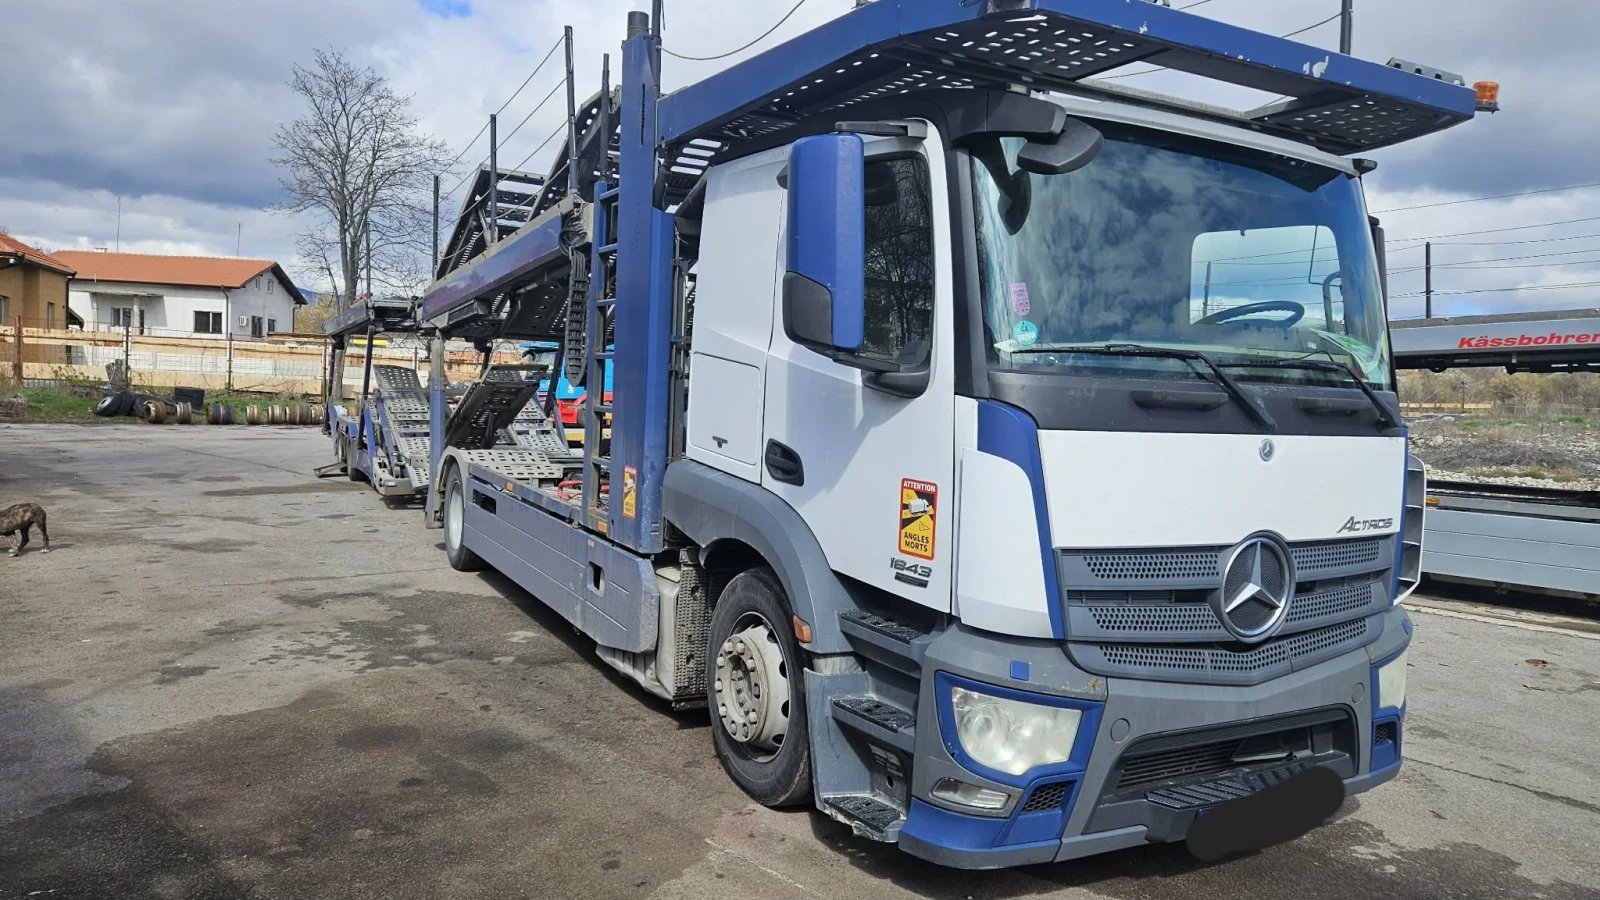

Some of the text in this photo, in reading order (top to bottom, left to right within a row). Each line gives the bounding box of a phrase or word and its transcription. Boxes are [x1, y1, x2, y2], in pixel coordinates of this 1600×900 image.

[1458, 332, 1600, 349] Kässbohrer
[903, 480, 936, 493] ATTENTION
[904, 531, 930, 544] ANGLES
[904, 540, 928, 553] MORTS
[890, 557, 933, 578] 1843
